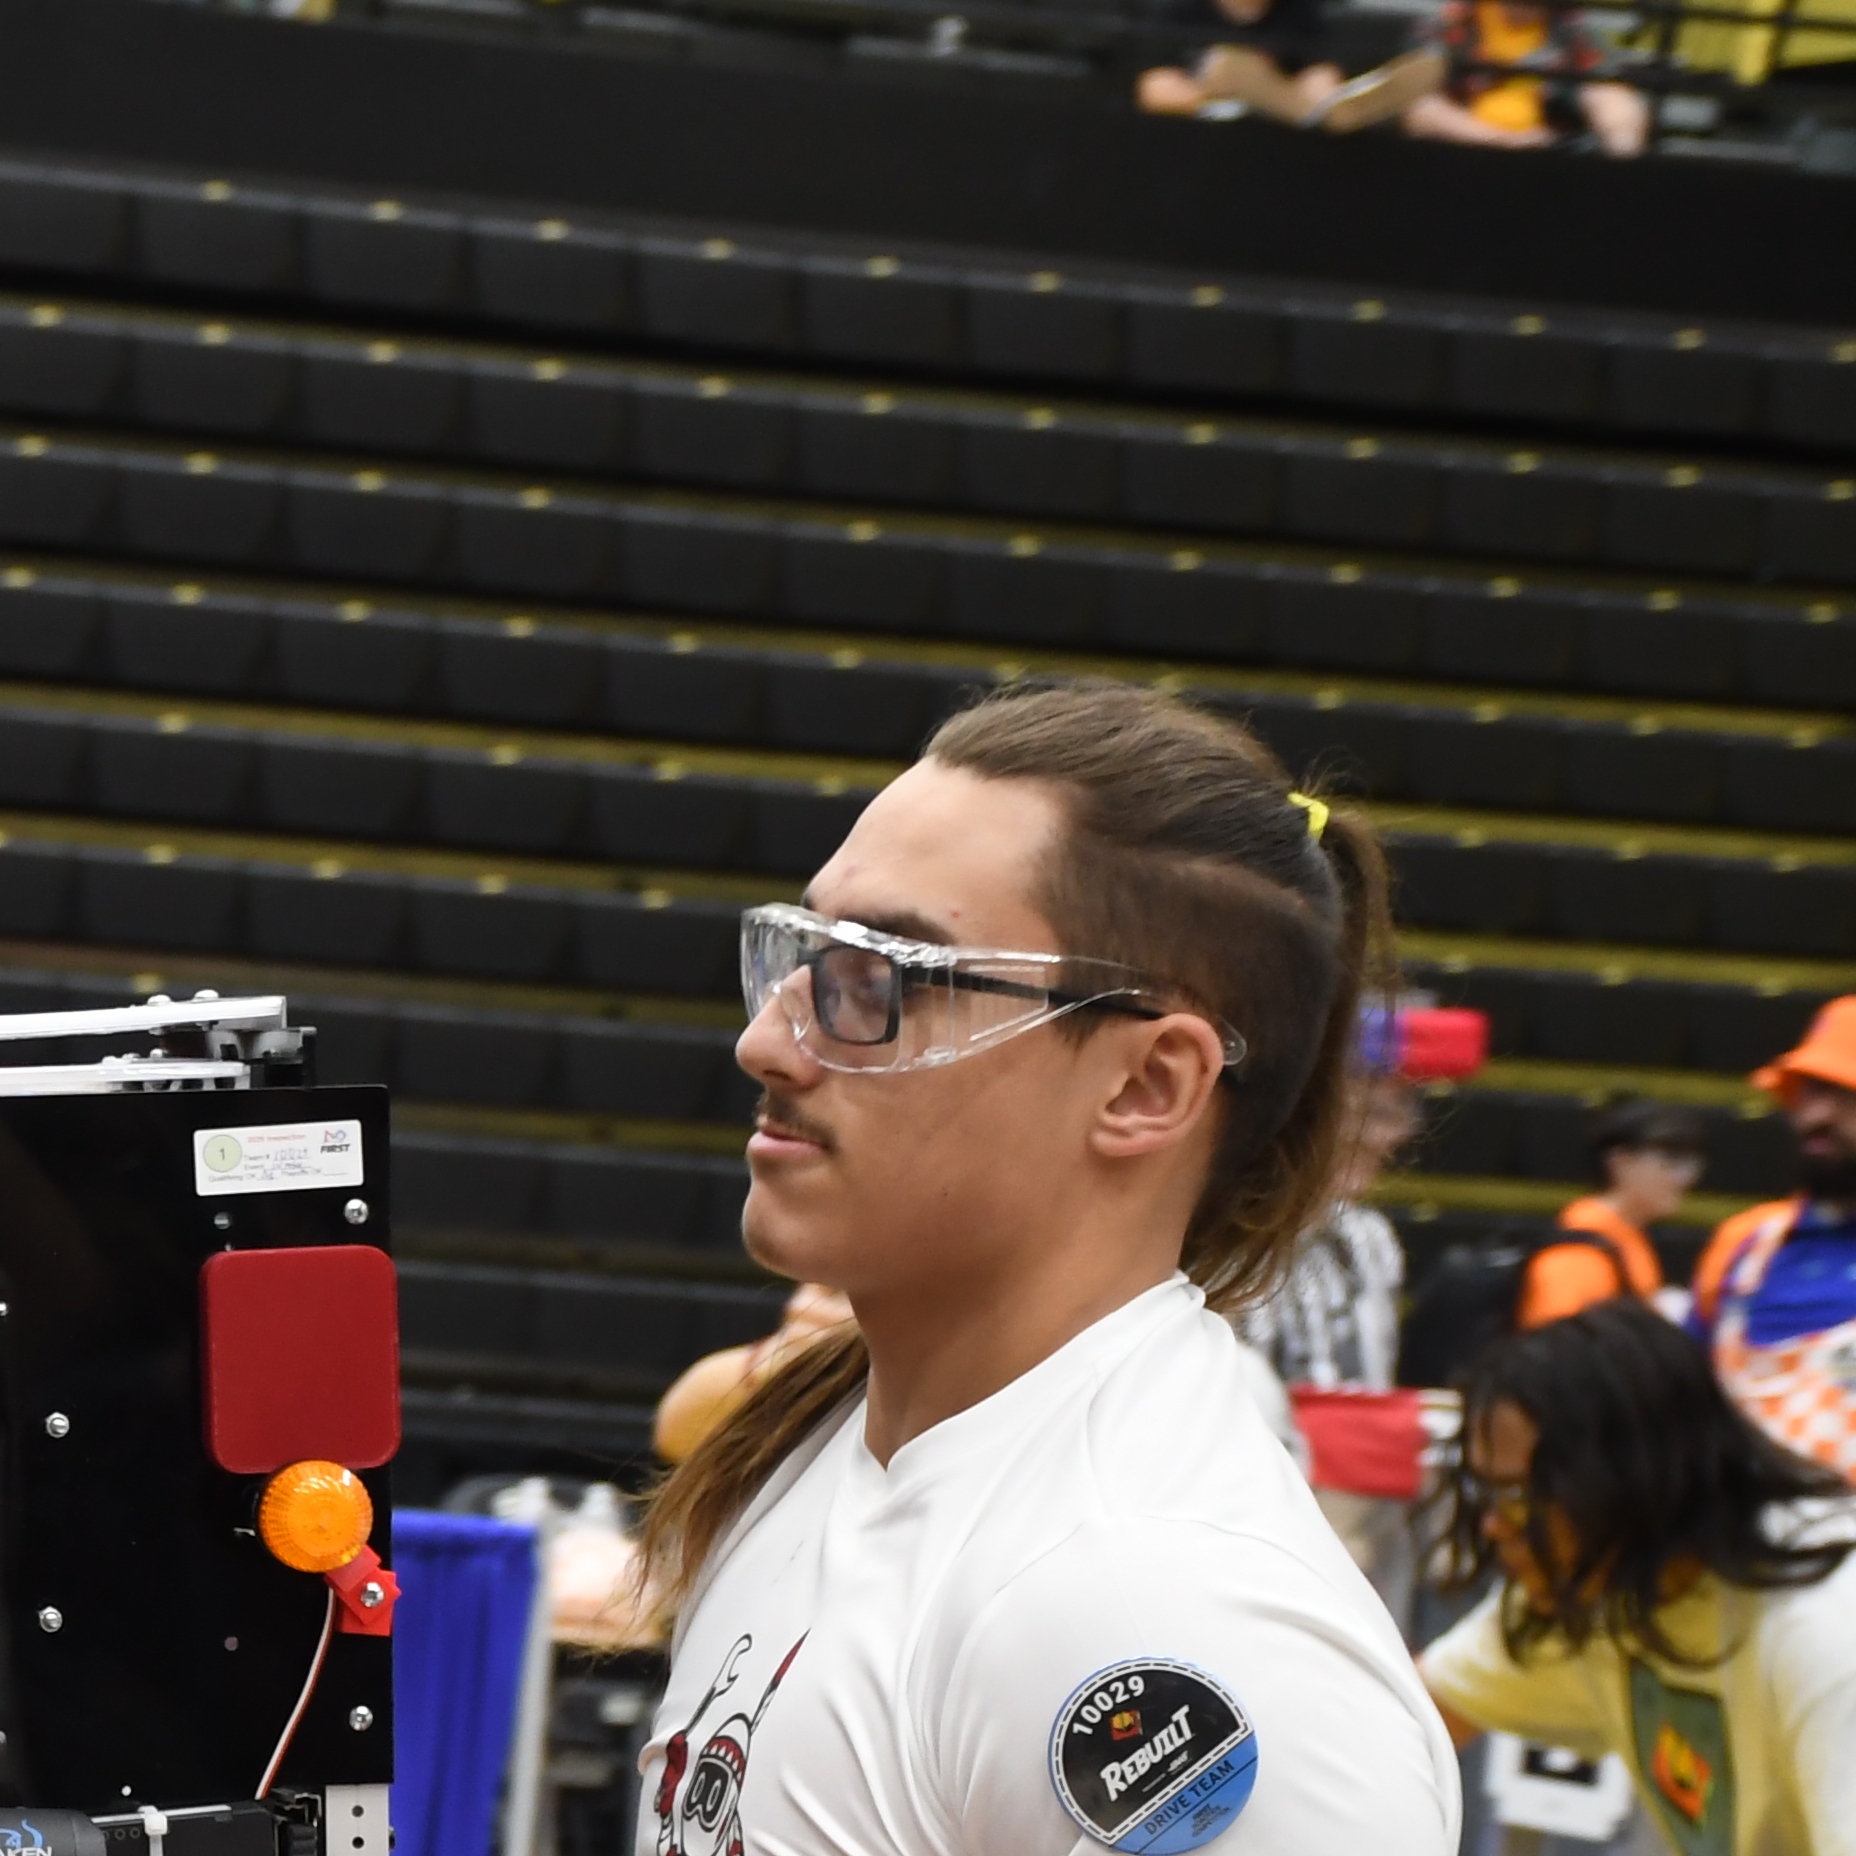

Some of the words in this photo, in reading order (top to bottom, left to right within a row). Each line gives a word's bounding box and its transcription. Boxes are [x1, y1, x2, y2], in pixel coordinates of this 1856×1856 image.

[320, 1144, 351, 1154] FIRST
[1072, 1675, 1146, 1736] 10029
[1099, 1704, 1191, 1803] REBUILT
[1143, 1794, 1192, 1836] DRIVE
[1188, 1760, 1236, 1799] TEAM
